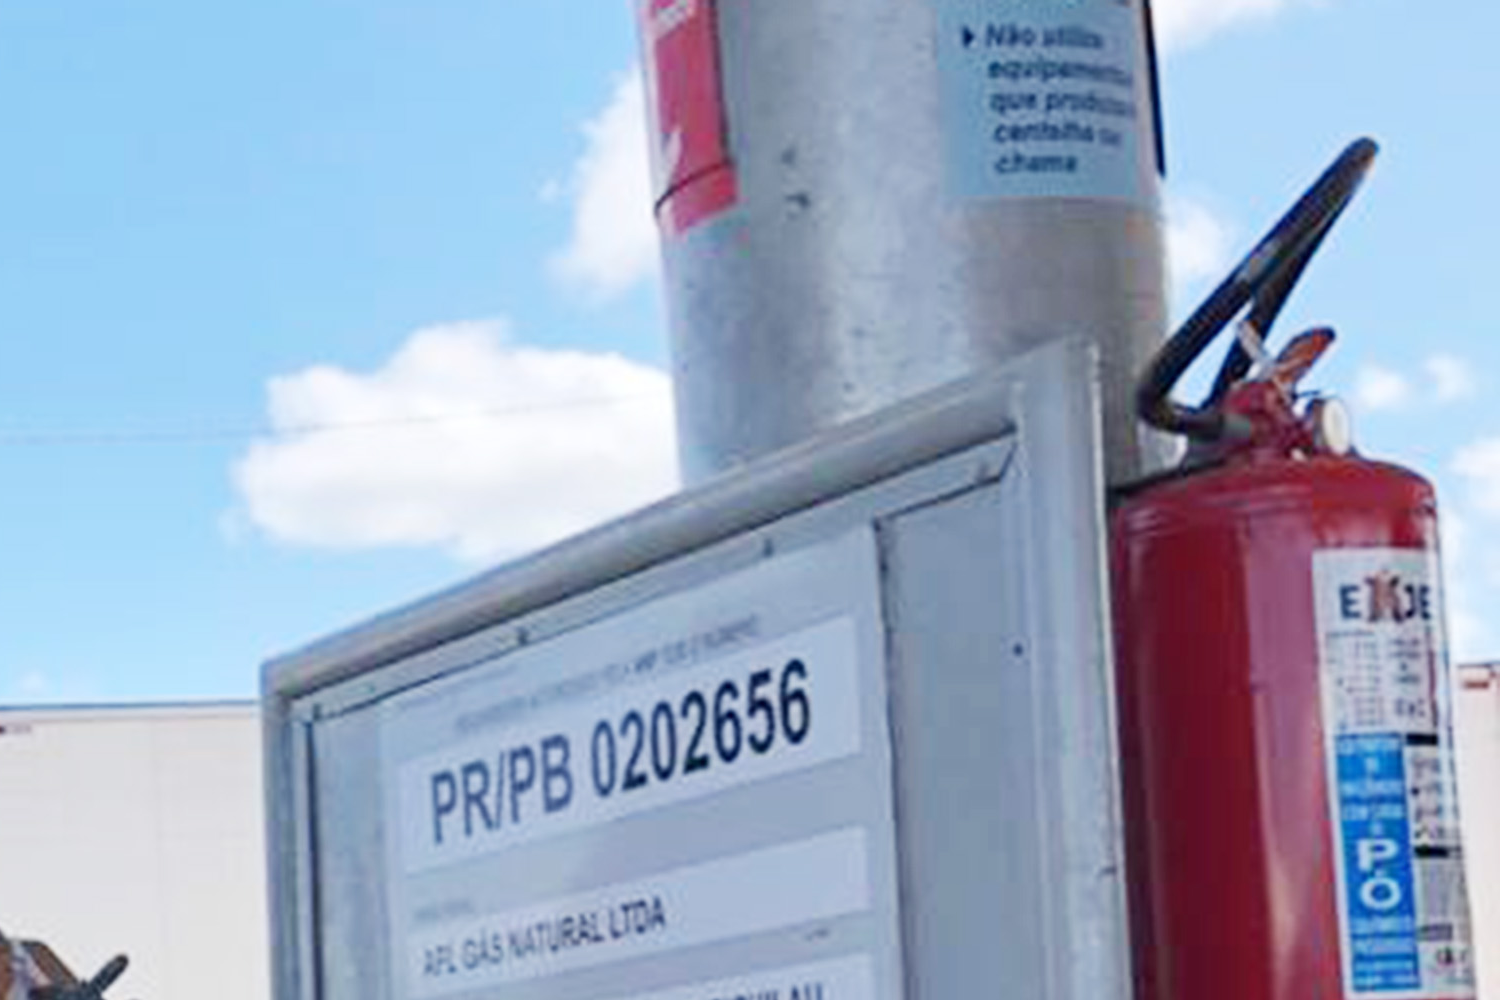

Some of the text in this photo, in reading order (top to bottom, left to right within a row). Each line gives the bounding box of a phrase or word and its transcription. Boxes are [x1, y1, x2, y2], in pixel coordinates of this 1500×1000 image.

[986, 22, 1035, 48] Não
[989, 92, 1037, 115] que
[994, 151, 1078, 174] chama
[430, 734, 574, 845] PR/PB
[590, 658, 813, 798] 0202656
[508, 912, 604, 958] NATURAL
[608, 895, 666, 939] LTDA
